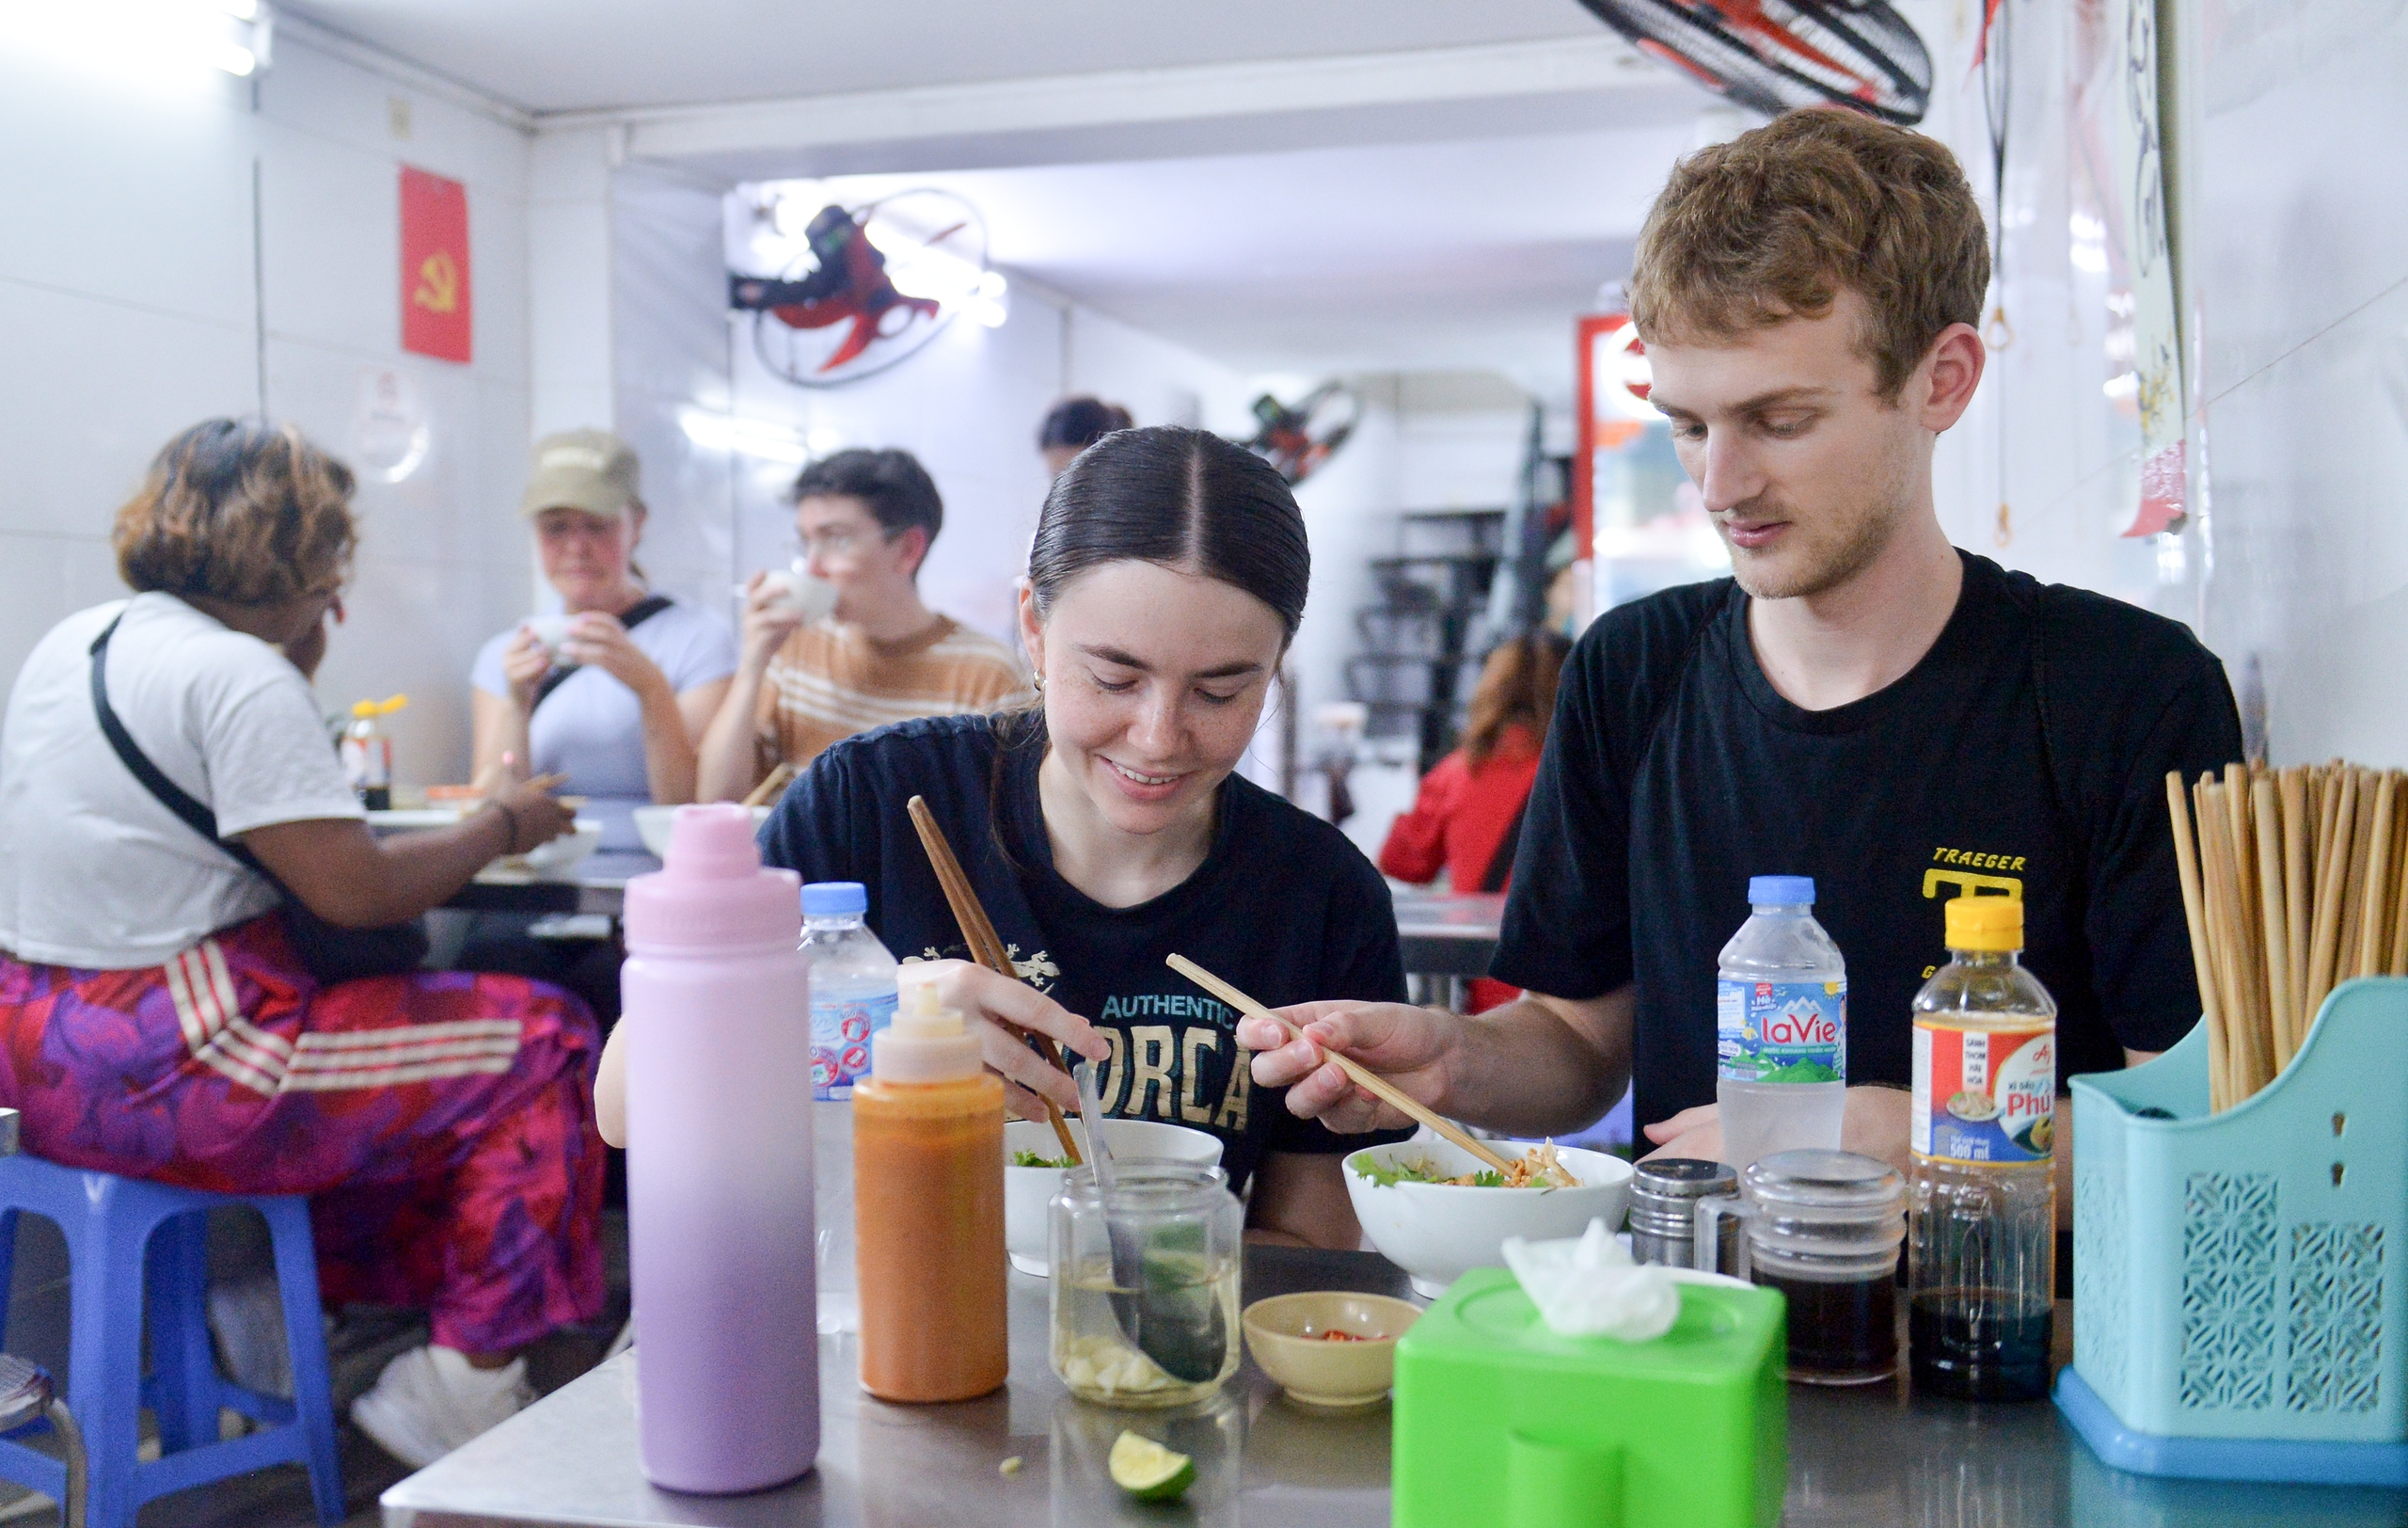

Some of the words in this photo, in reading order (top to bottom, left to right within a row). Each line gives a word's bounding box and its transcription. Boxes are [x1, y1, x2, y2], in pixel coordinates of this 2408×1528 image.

[1933, 847, 2026, 870] TRAEGER
[1101, 995, 1234, 1030] AUTHENTIC
[2007, 1089, 2051, 1117] Phú
[1950, 1143, 1971, 1158] 500
[1973, 1145, 1989, 1160] ml
